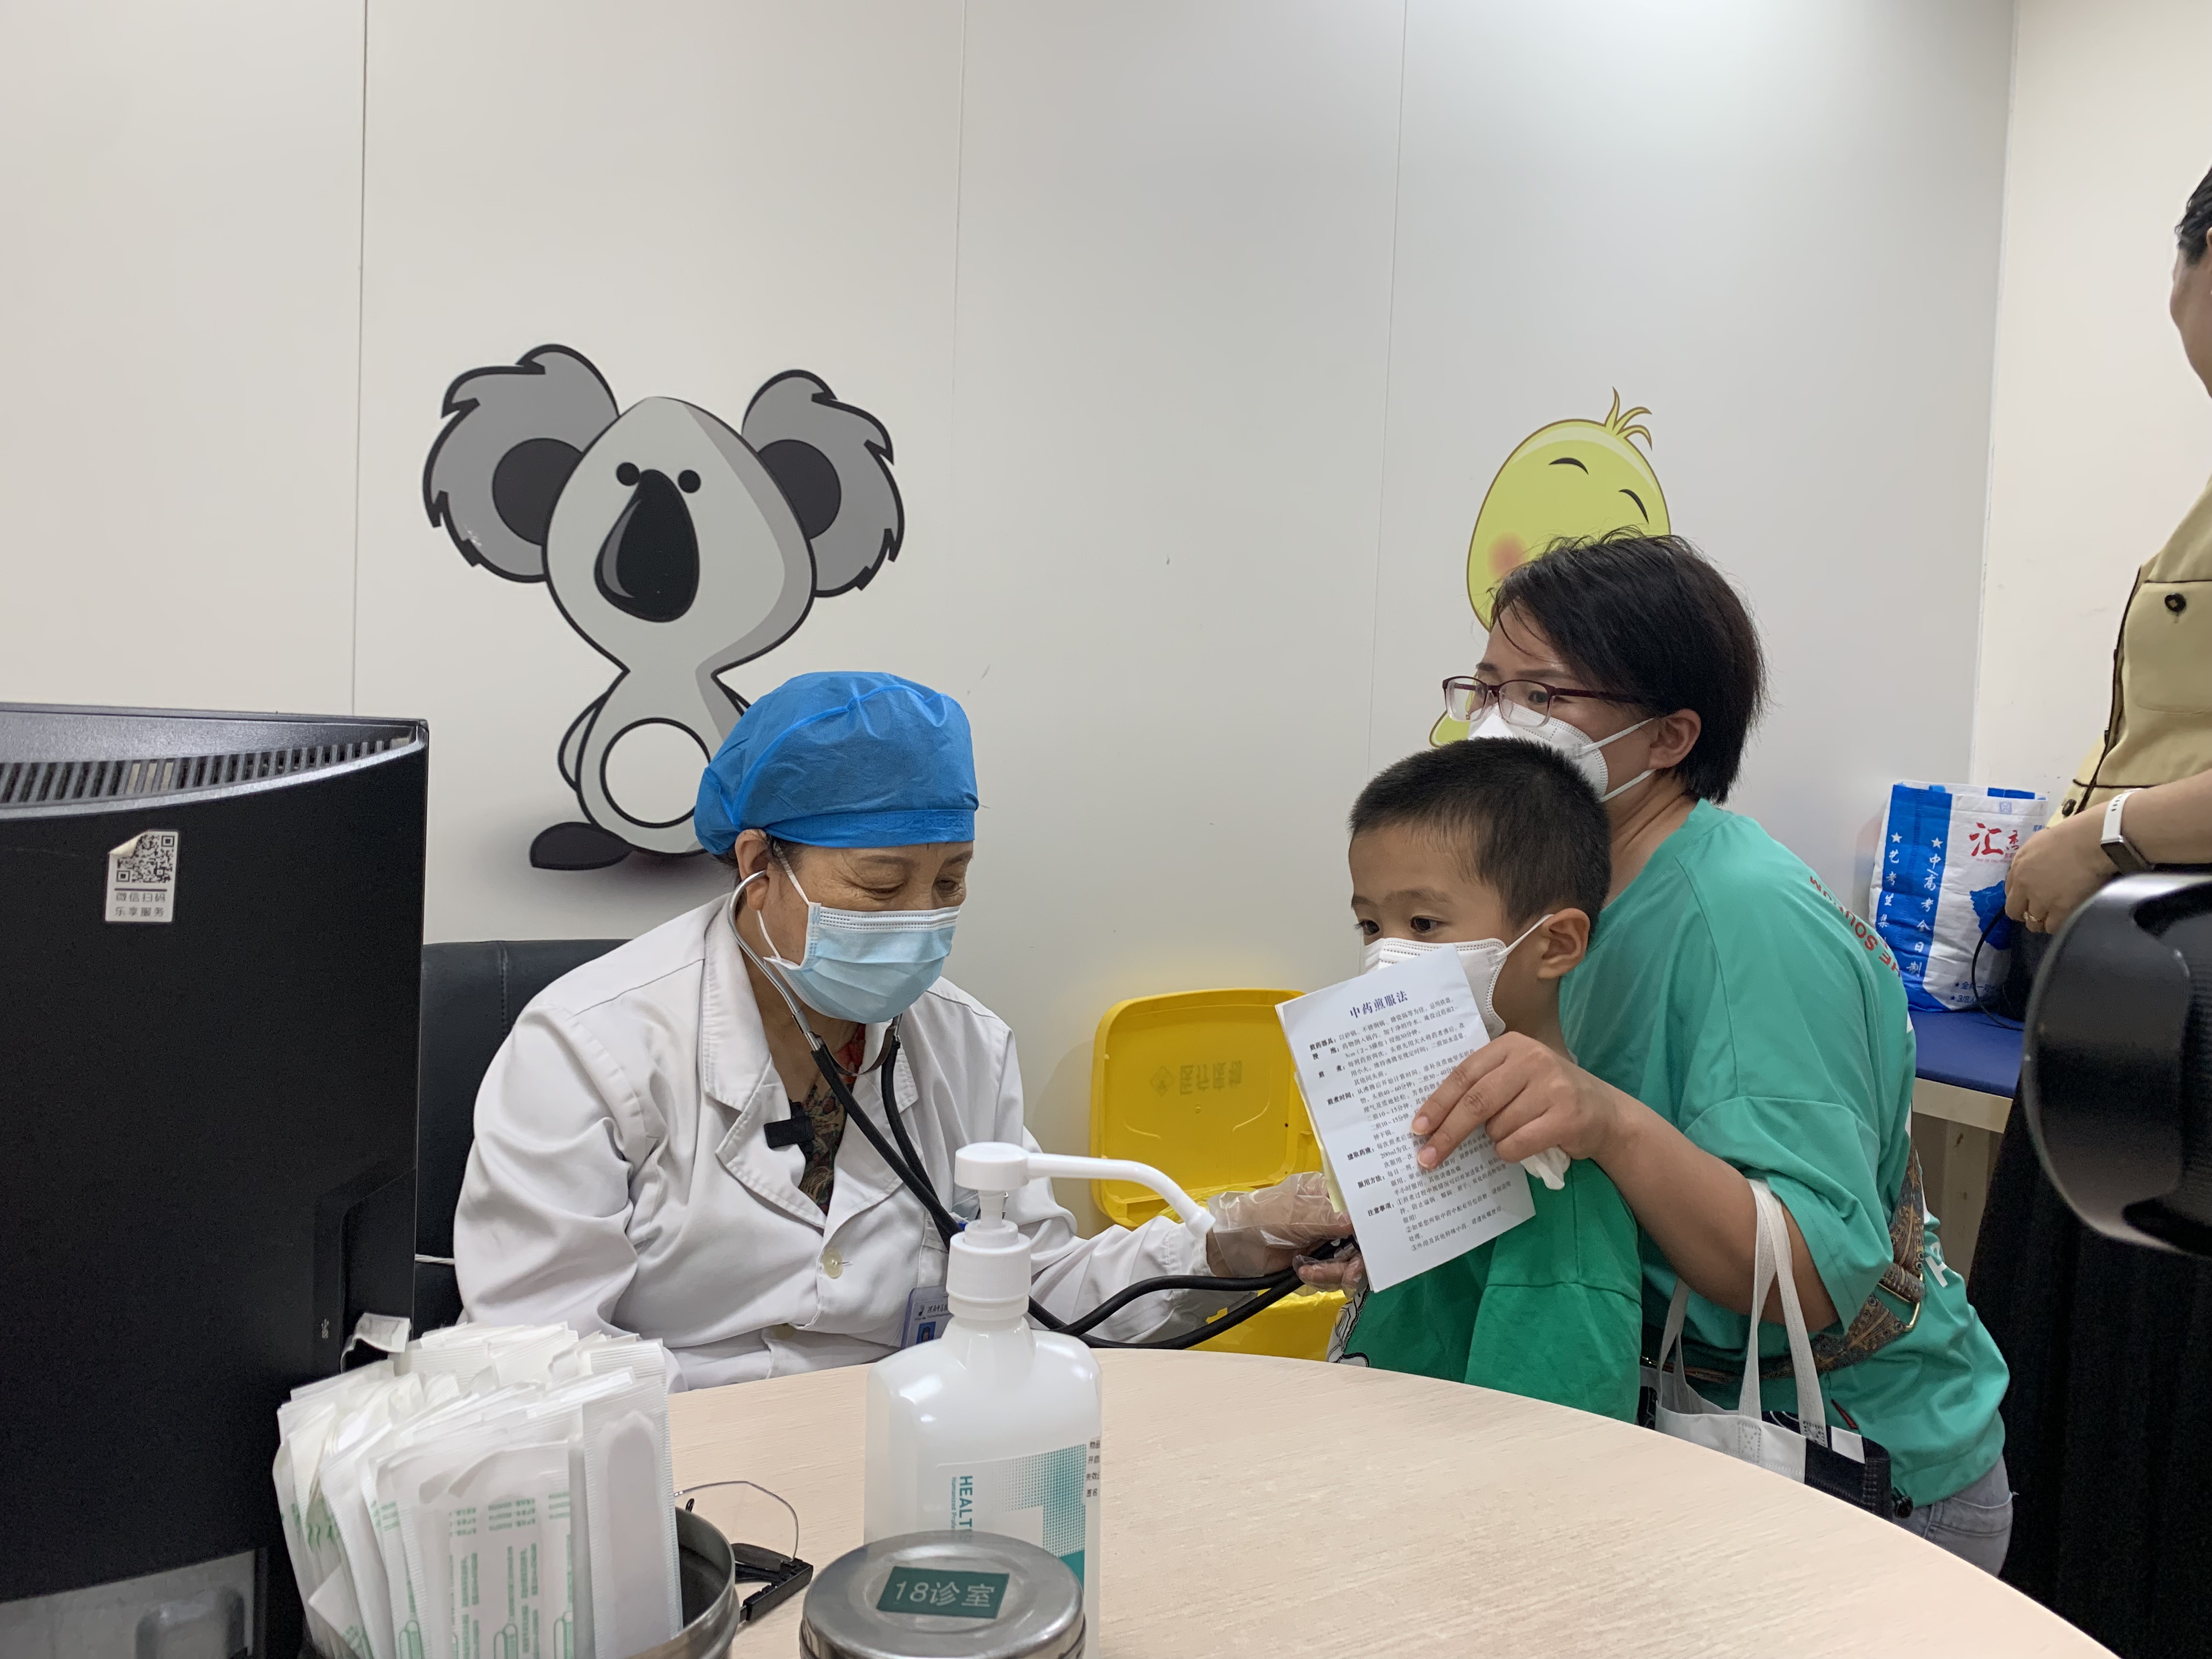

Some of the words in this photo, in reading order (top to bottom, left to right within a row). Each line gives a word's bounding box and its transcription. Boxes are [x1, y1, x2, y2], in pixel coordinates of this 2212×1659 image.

[115, 893, 166, 902] 微信扫码
[1878, 849, 1899, 944] 艺考生集
[115, 906, 165, 917] 乐享服务
[1350, 990, 1408, 1018] 中药煎服法
[1308, 1036, 1336, 1051] 煎药器具：
[1326, 1091, 1354, 1106] 煎煮时间：
[1369, 1108, 1419, 1132] 二煎10~15分钟。
[1347, 1146, 1374, 1161] 滤取药液：
[1357, 1173, 1385, 1188] 服用方法：
[1367, 1201, 1395, 1216] 注意事项：
[959, 1476, 973, 1532] HEALT
[895, 1580, 995, 1608] 18诊室
